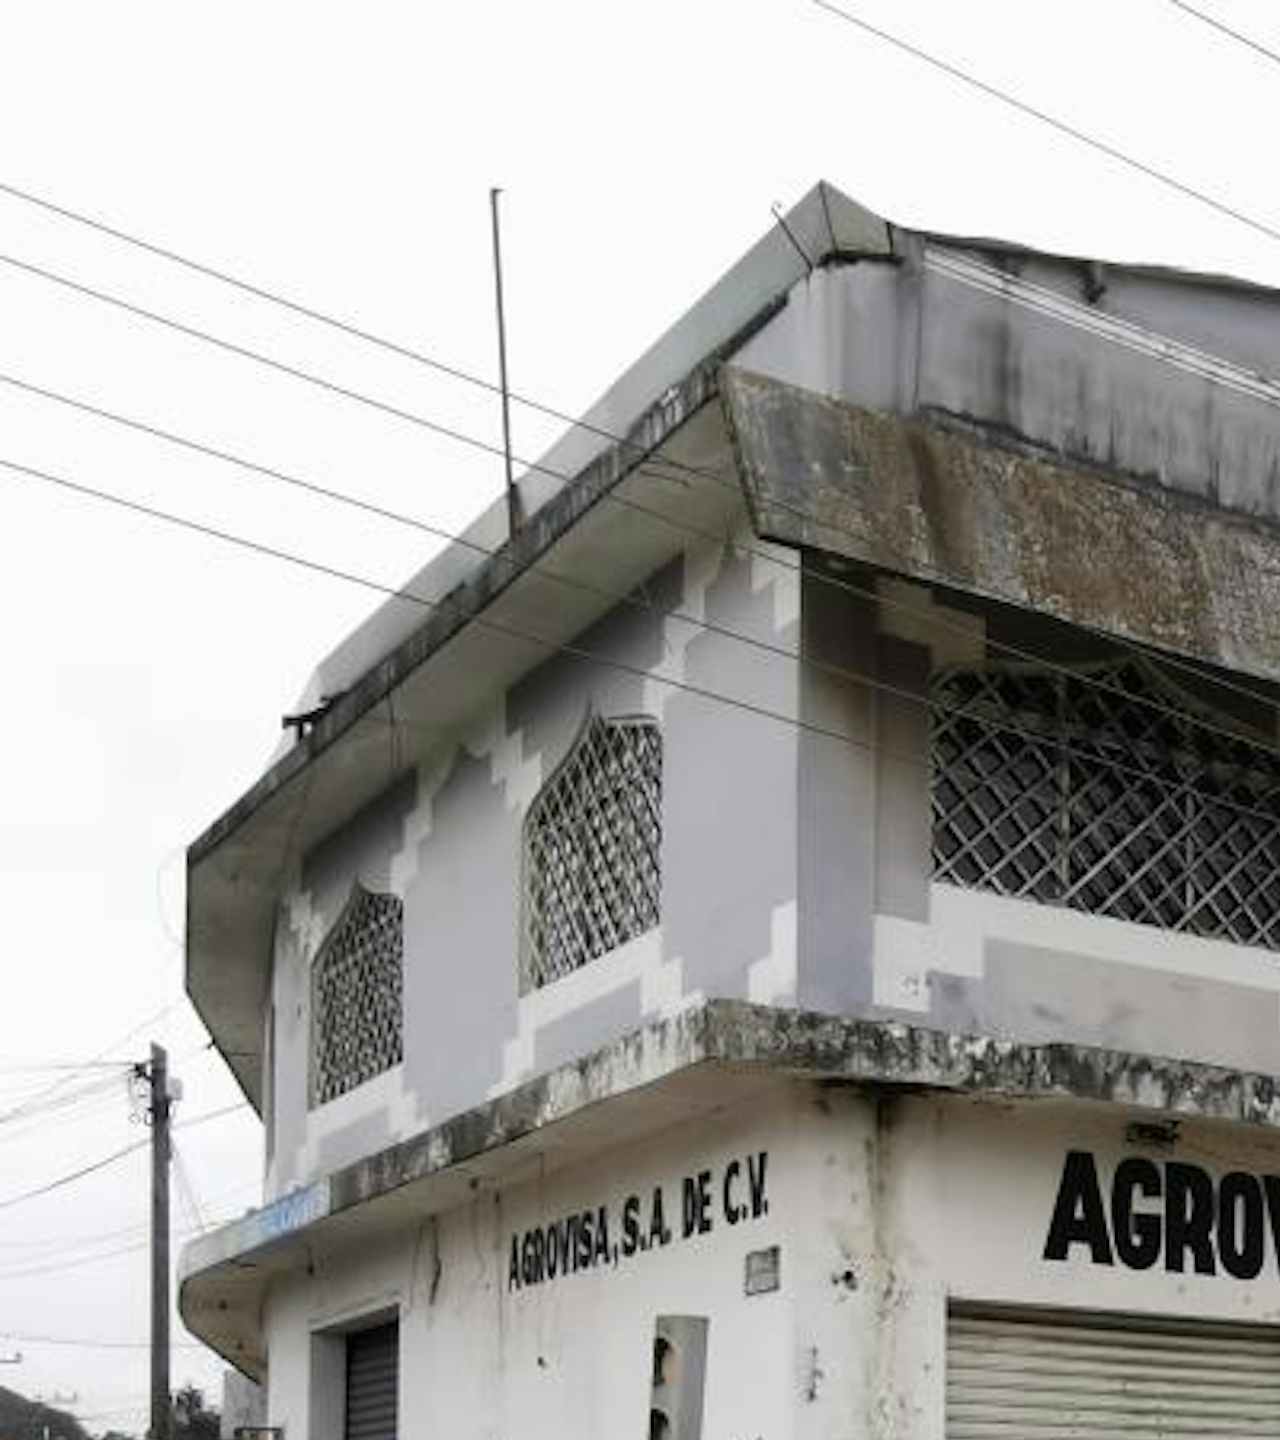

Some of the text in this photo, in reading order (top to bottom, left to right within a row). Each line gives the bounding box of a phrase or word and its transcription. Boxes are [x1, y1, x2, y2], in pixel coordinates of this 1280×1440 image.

[509, 1151, 769, 1293] AGROVISA, S.A. DE C.V.
